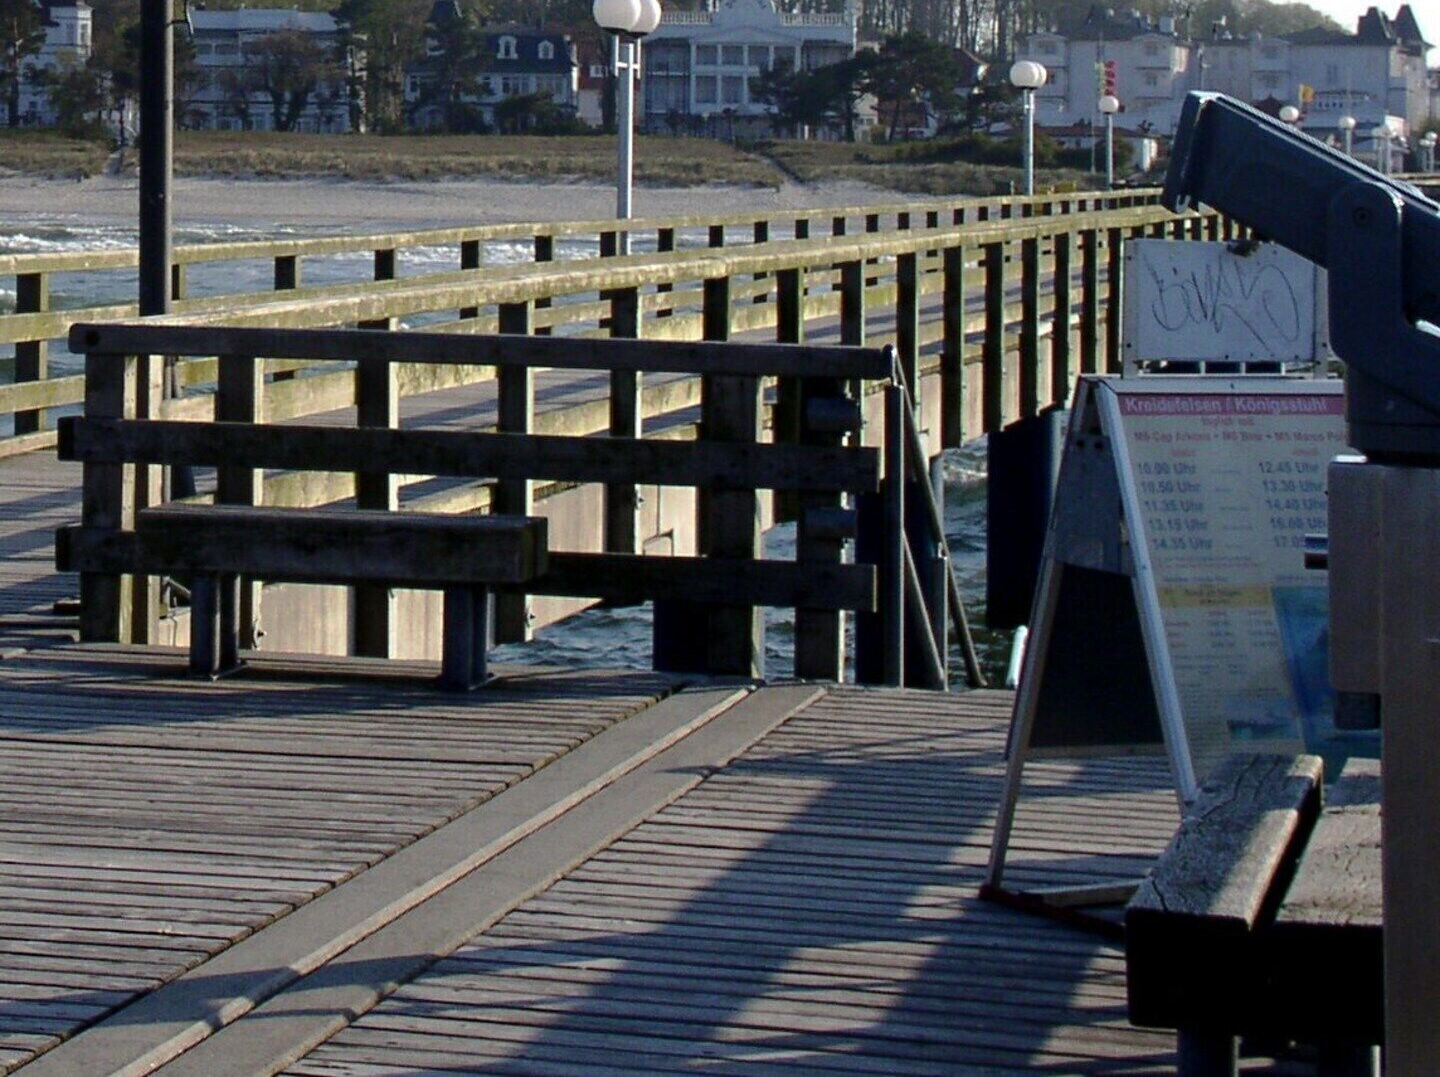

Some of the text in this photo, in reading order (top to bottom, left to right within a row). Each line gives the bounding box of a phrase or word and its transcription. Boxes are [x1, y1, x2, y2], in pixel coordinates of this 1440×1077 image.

[1125, 397, 1222, 412] Kreidefelsen
[1235, 396, 1328, 414] Königsstuhl
[1173, 461, 1197, 474] Uhr
[1258, 461, 1292, 473] 12.45
[1176, 480, 1201, 493] Uhr
[1179, 499, 1204, 512] Uhr
[1184, 517, 1208, 530] Uhr
[1306, 517, 1327, 529] Uh
[1188, 536, 1213, 550] Uhr
